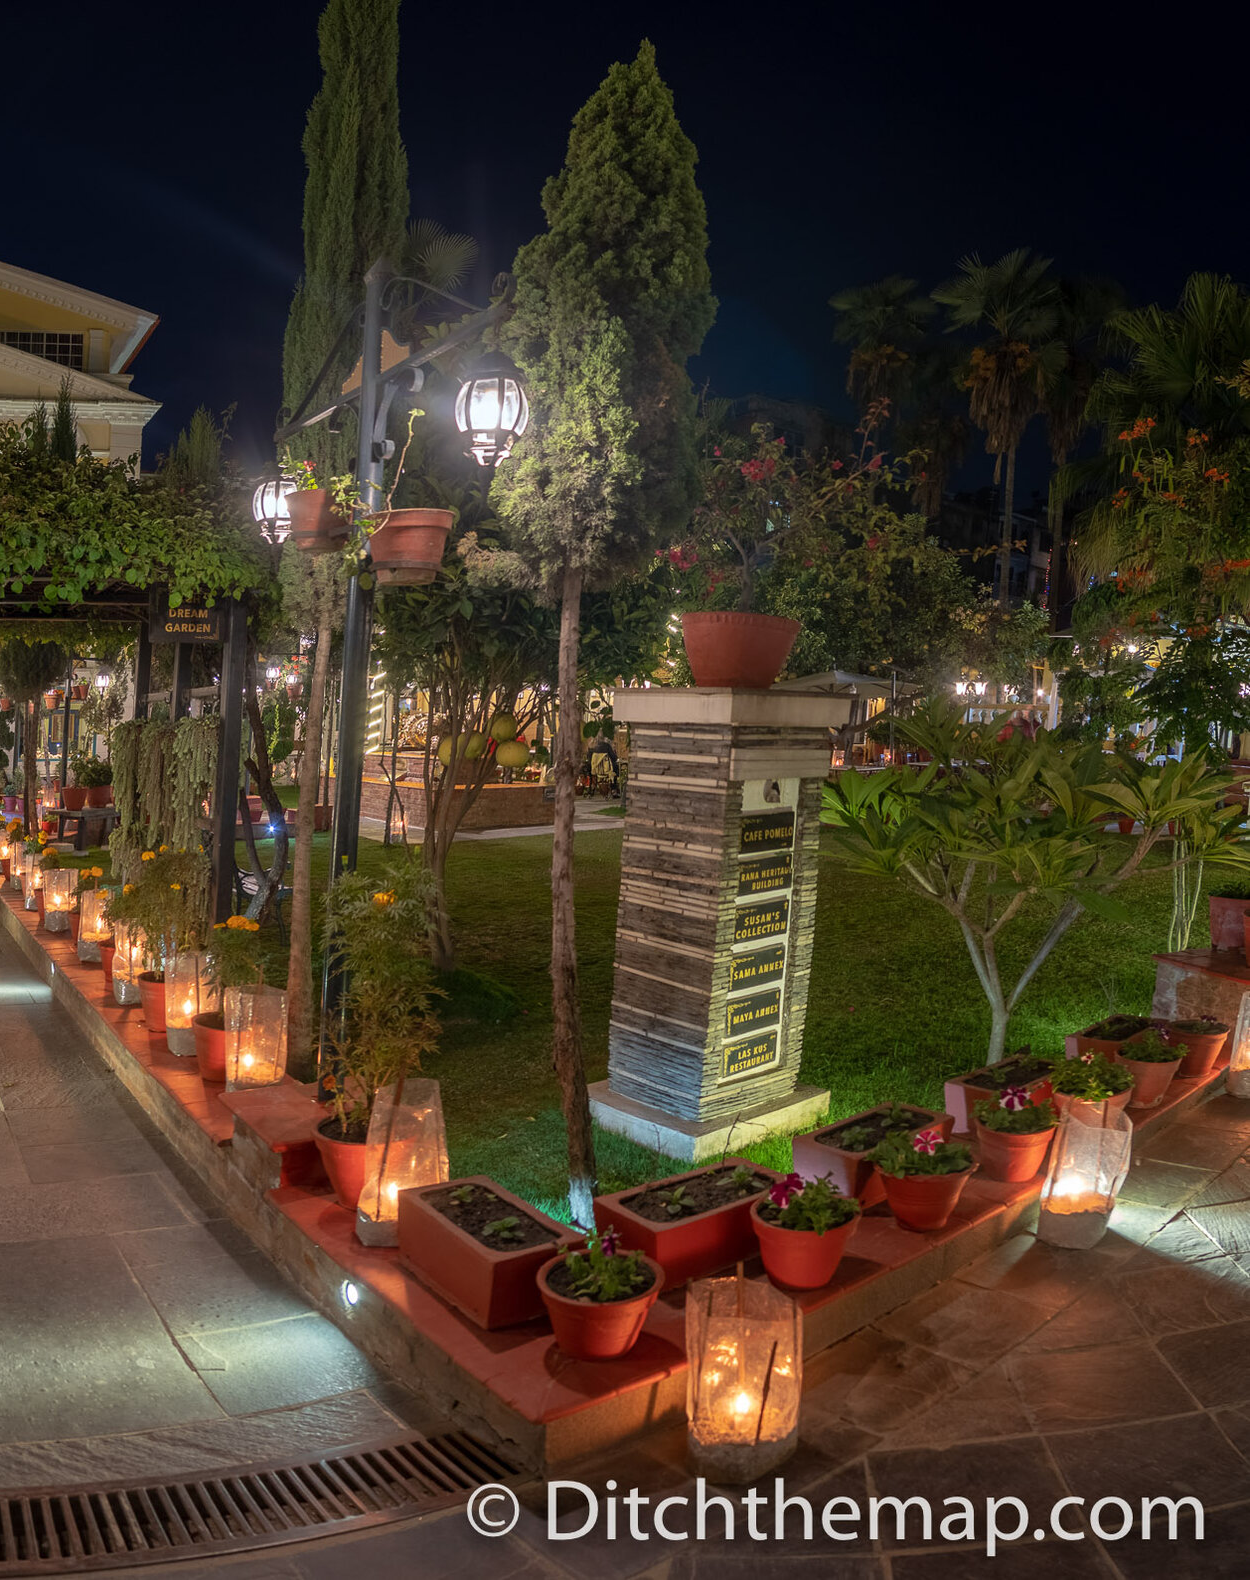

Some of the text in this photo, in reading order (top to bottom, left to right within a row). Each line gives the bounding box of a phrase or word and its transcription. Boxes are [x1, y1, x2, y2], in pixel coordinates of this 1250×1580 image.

[168, 608, 209, 618] DREAM
[165, 623, 211, 633] GARDEN
[743, 826, 793, 842] CAFE POMELO
[741, 871, 759, 882] RANA
[751, 877, 784, 890] BUILDING
[744, 911, 781, 926] SUSAN'S
[735, 921, 786, 939] COLLECTION
[733, 960, 784, 980] SAMA ANNEX
[732, 1004, 779, 1024] MAYA ANNEX
[738, 1043, 768, 1060] LAS KUS
[729, 1050, 774, 1073] RESTAURANT
